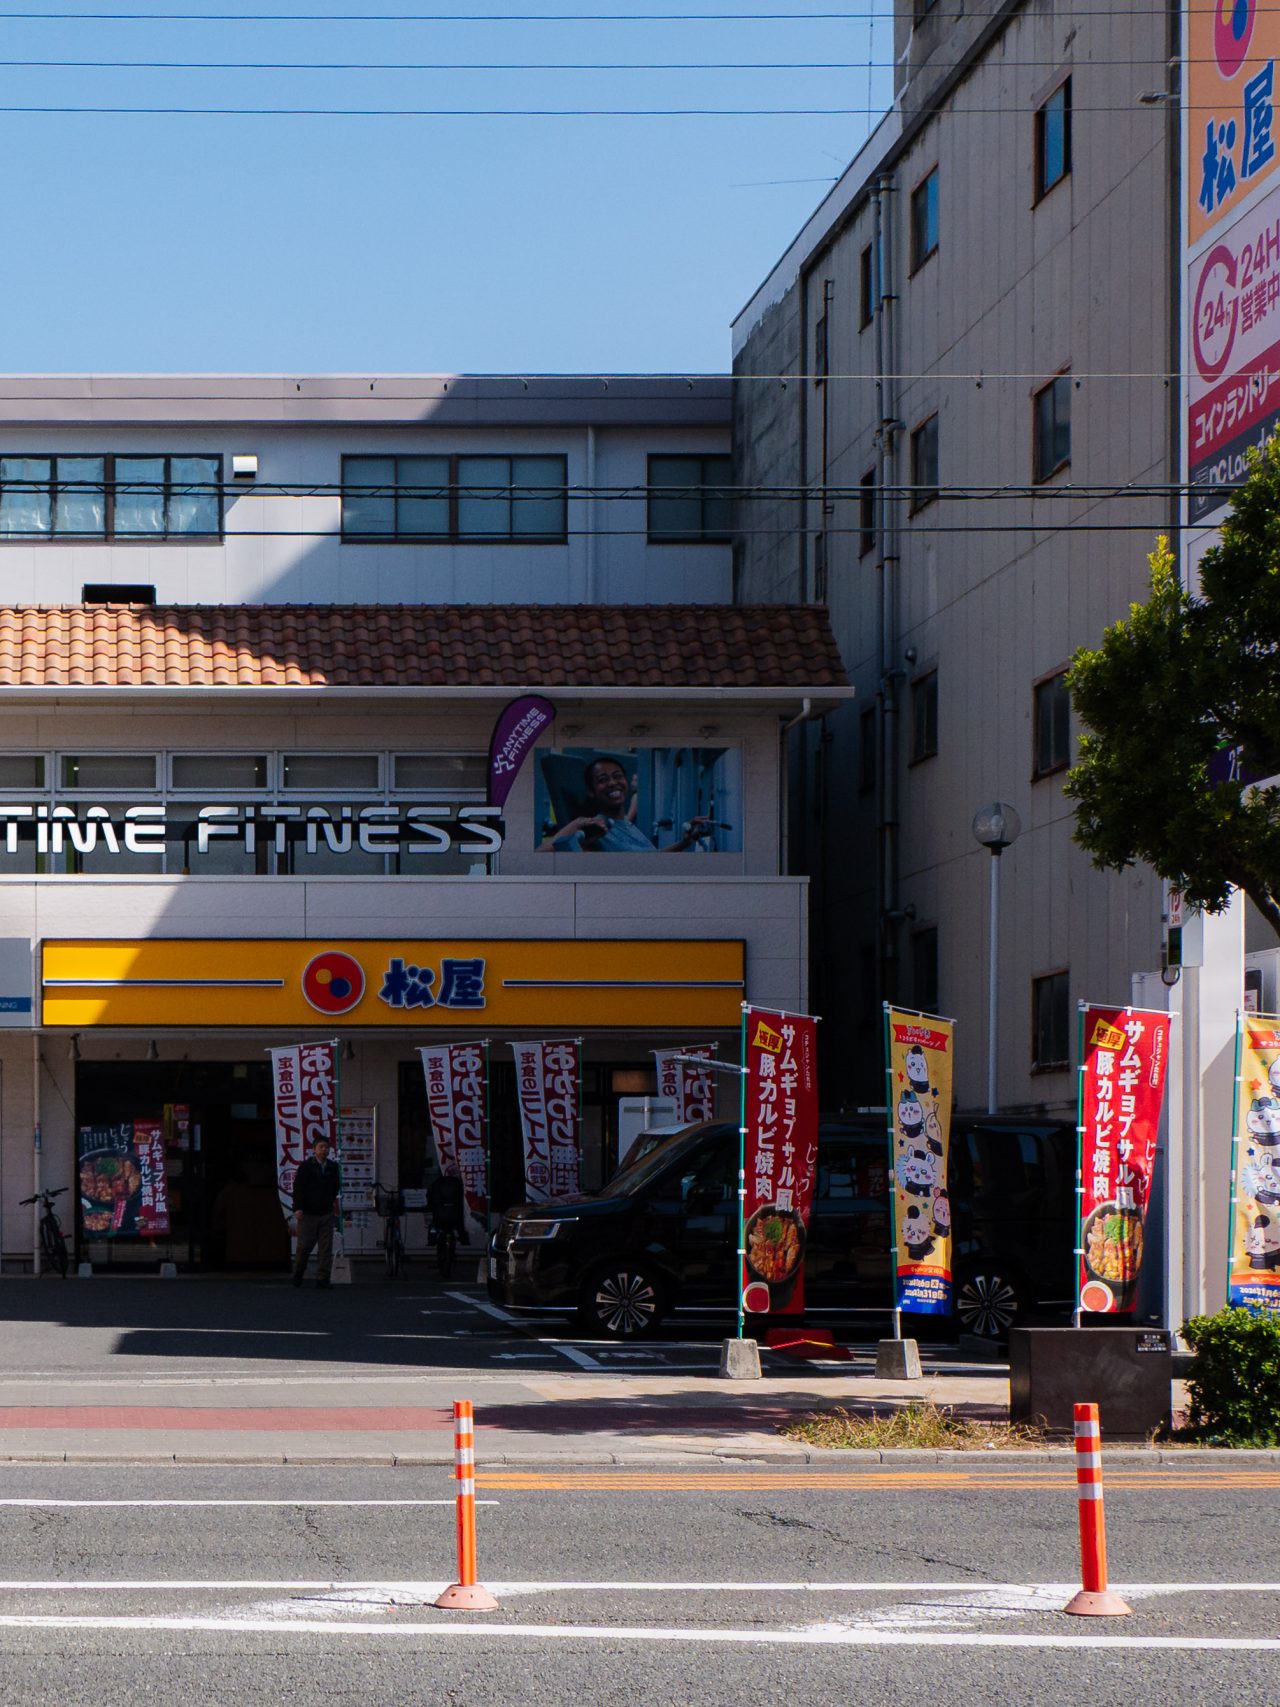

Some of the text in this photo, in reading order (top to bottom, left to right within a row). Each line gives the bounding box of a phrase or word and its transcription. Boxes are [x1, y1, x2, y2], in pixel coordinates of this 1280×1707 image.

[1198, 58, 1276, 215] 松屋
[1241, 218, 1280, 291] 24H
[1241, 270, 1280, 336] 営業中
[1195, 364, 1280, 449] コインランドリー
[502, 707, 540, 756] ANYTIME
[508, 712, 547, 762] FITNESS
[196, 805, 504, 856] FITNESS
[378, 957, 487, 1010] 松屋
[1096, 1028, 1123, 1048] 極厚
[755, 1052, 779, 1201] 豚カルビ焼肉
[775, 1023, 798, 1213] サムギョプサル風
[1092, 1050, 1115, 1199] 豚カルビ焼肉
[1114, 1020, 1145, 1211] サムギョプサル風
[138, 1144, 154, 1207] 豚カルビ焼肉
[150, 1130, 168, 1213] サムギョプサル風
